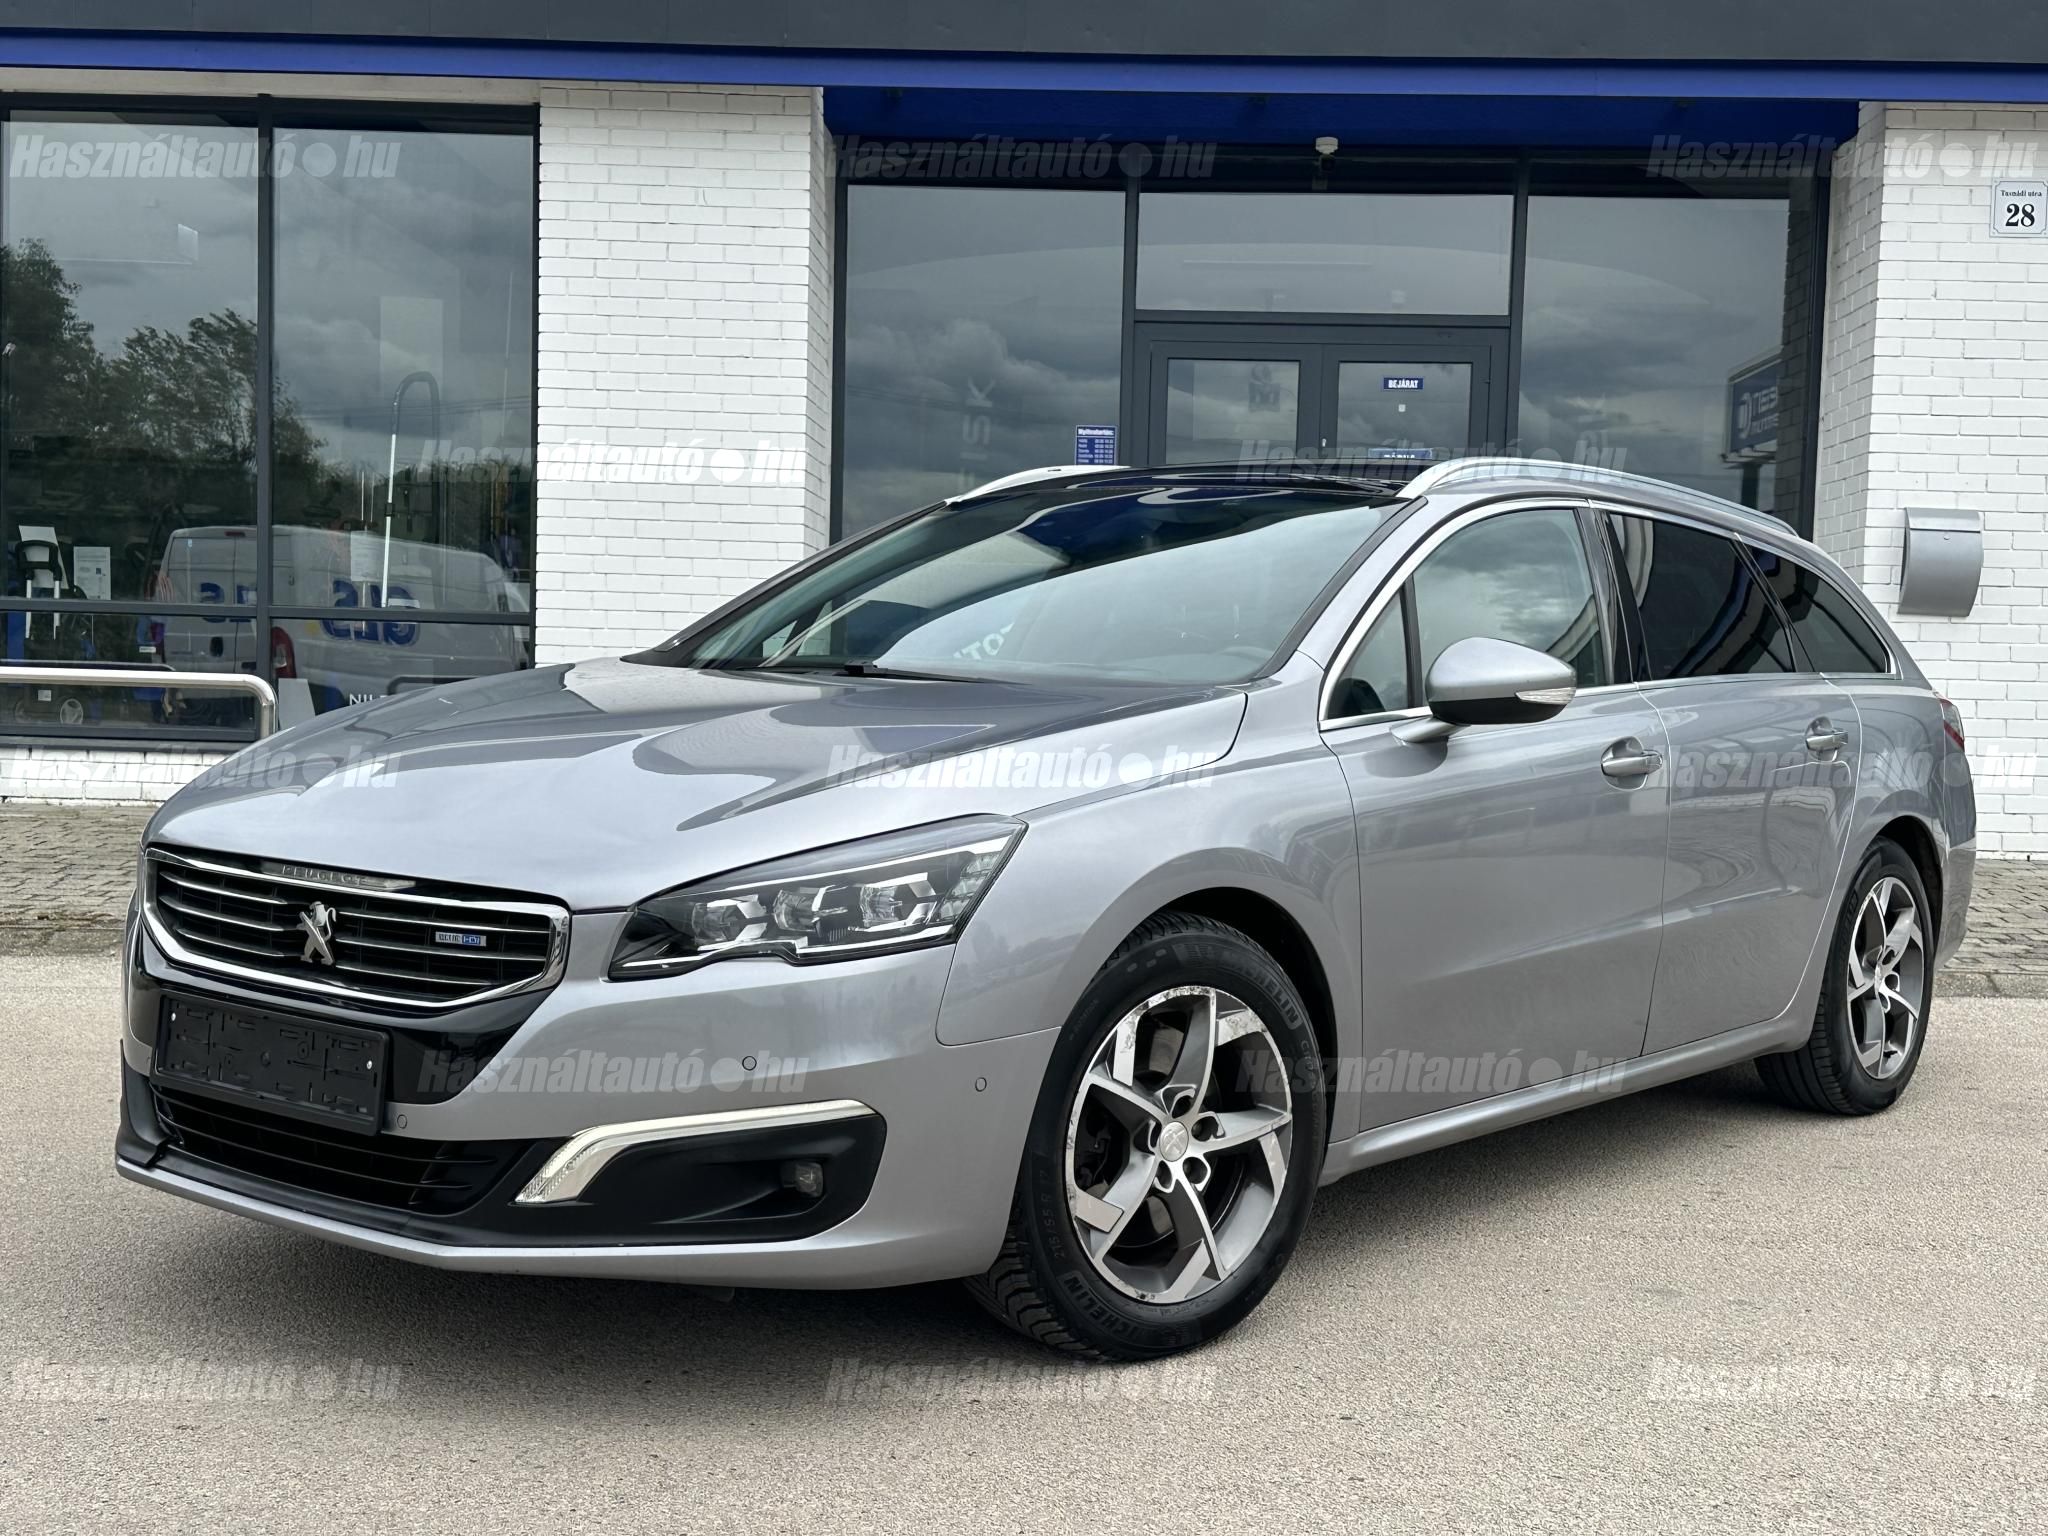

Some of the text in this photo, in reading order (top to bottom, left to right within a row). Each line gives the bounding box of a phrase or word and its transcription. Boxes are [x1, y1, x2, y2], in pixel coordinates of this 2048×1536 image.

[2005, 203, 2035, 227] 28
[1388, 378, 1419, 389] BEJÁRAT
[1226, 960, 1298, 1024] CHELIN
[1064, 1276, 1150, 1341] ICHELIN
